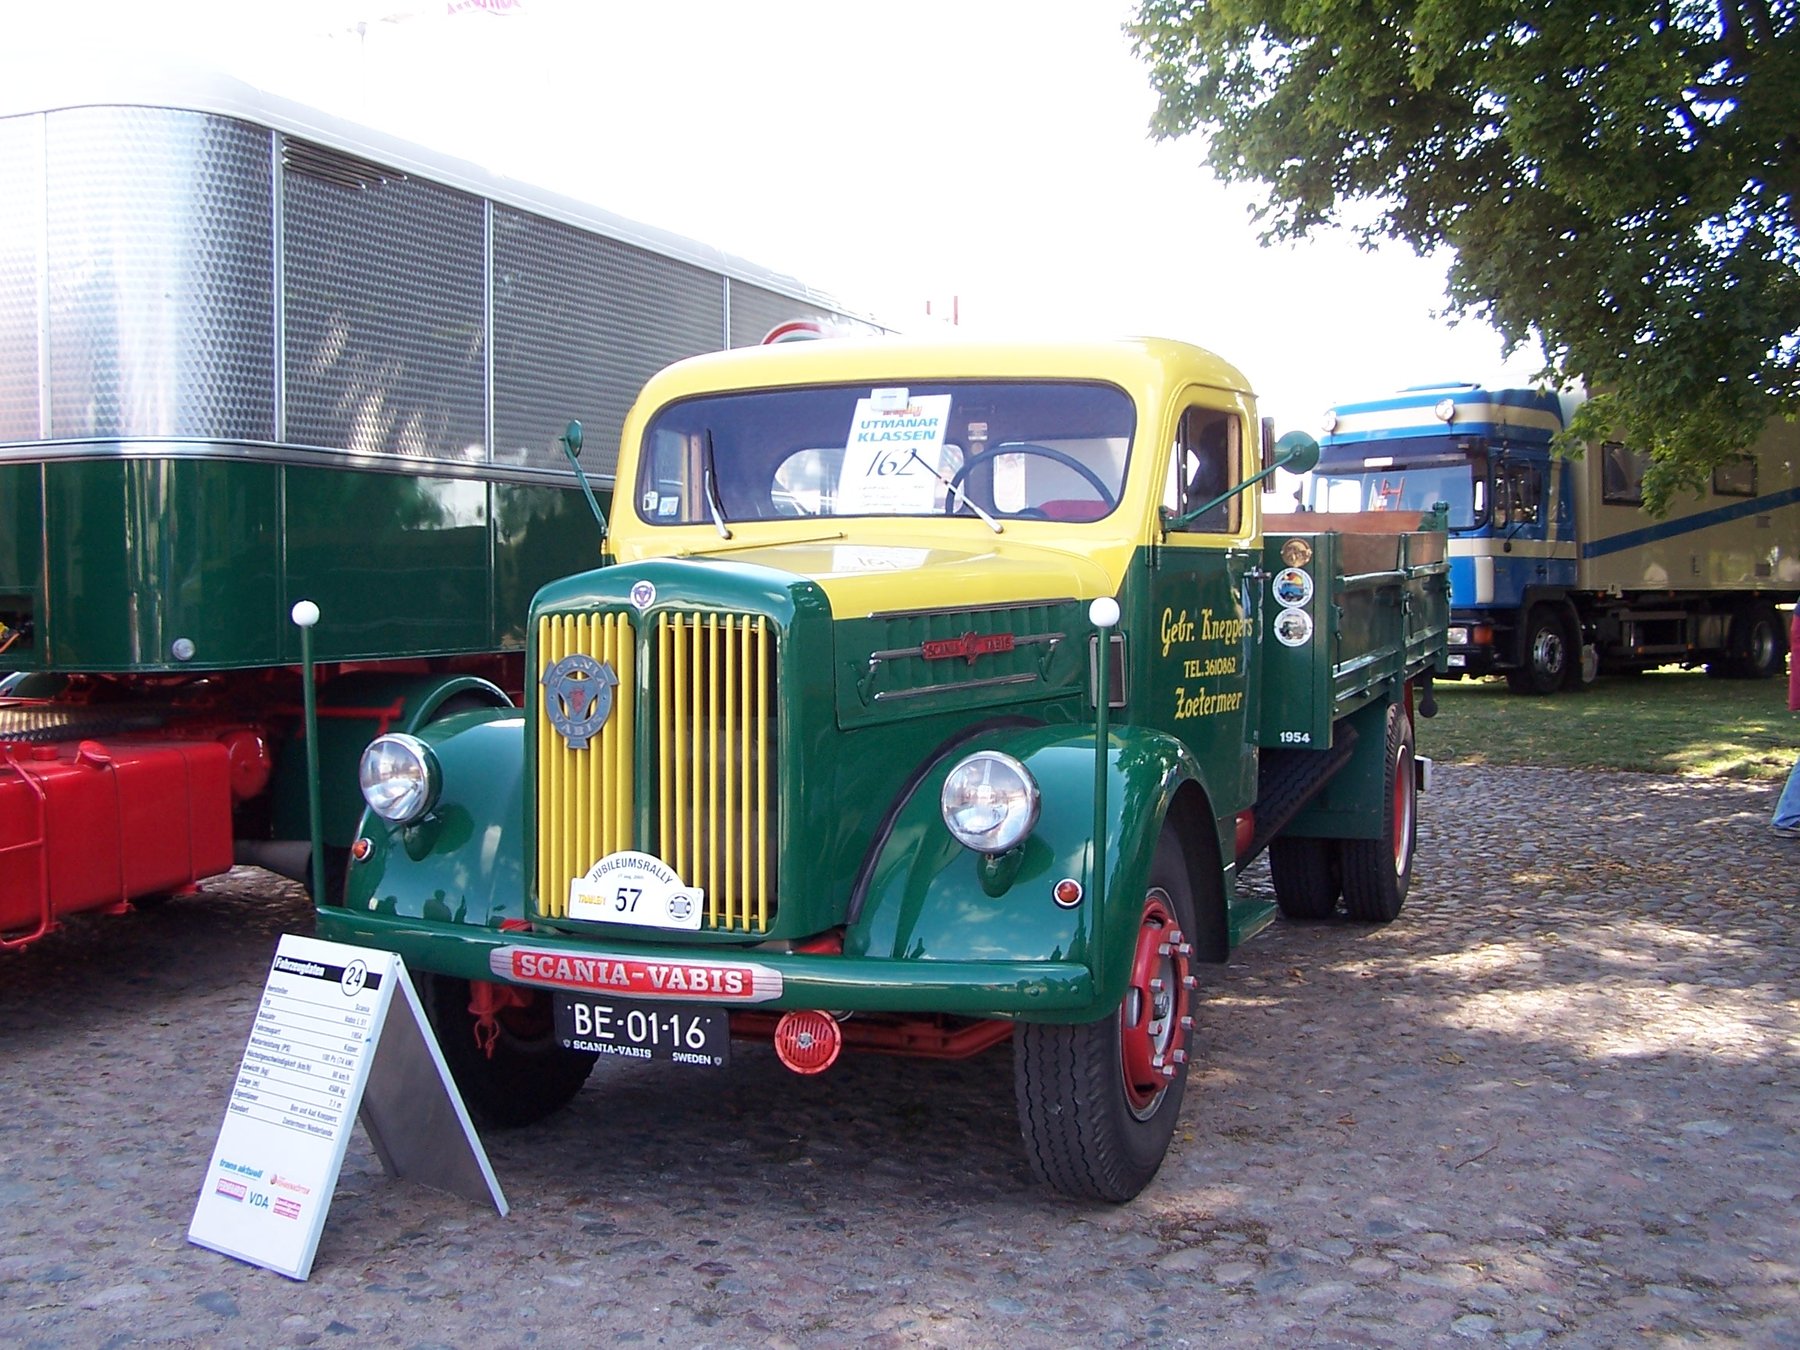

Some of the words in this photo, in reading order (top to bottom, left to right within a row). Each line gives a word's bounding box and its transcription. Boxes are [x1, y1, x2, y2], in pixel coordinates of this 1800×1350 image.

[861, 418, 939, 430] UTMANAR
[857, 430, 936, 442] KLASSEN
[866, 448, 917, 477] 162
[1161, 607, 1195, 657] Gebr.
[1201, 608, 1254, 645] Kneppers
[552, 659, 607, 690] SCANIA
[1174, 687, 1243, 720] Zoetermeer
[554, 713, 604, 736] VABIS
[1279, 732, 1310, 743] 1954
[593, 858, 674, 885] JUBILEUMSRALLY
[615, 887, 643, 912] 57
[345, 966, 364, 987] 24
[520, 954, 745, 994] SCANIA-VABIS
[573, 1040, 652, 1059] SCANIA-VABIS
[672, 1052, 712, 1065] SWEDEN
[249, 1191, 269, 1209] VDA
